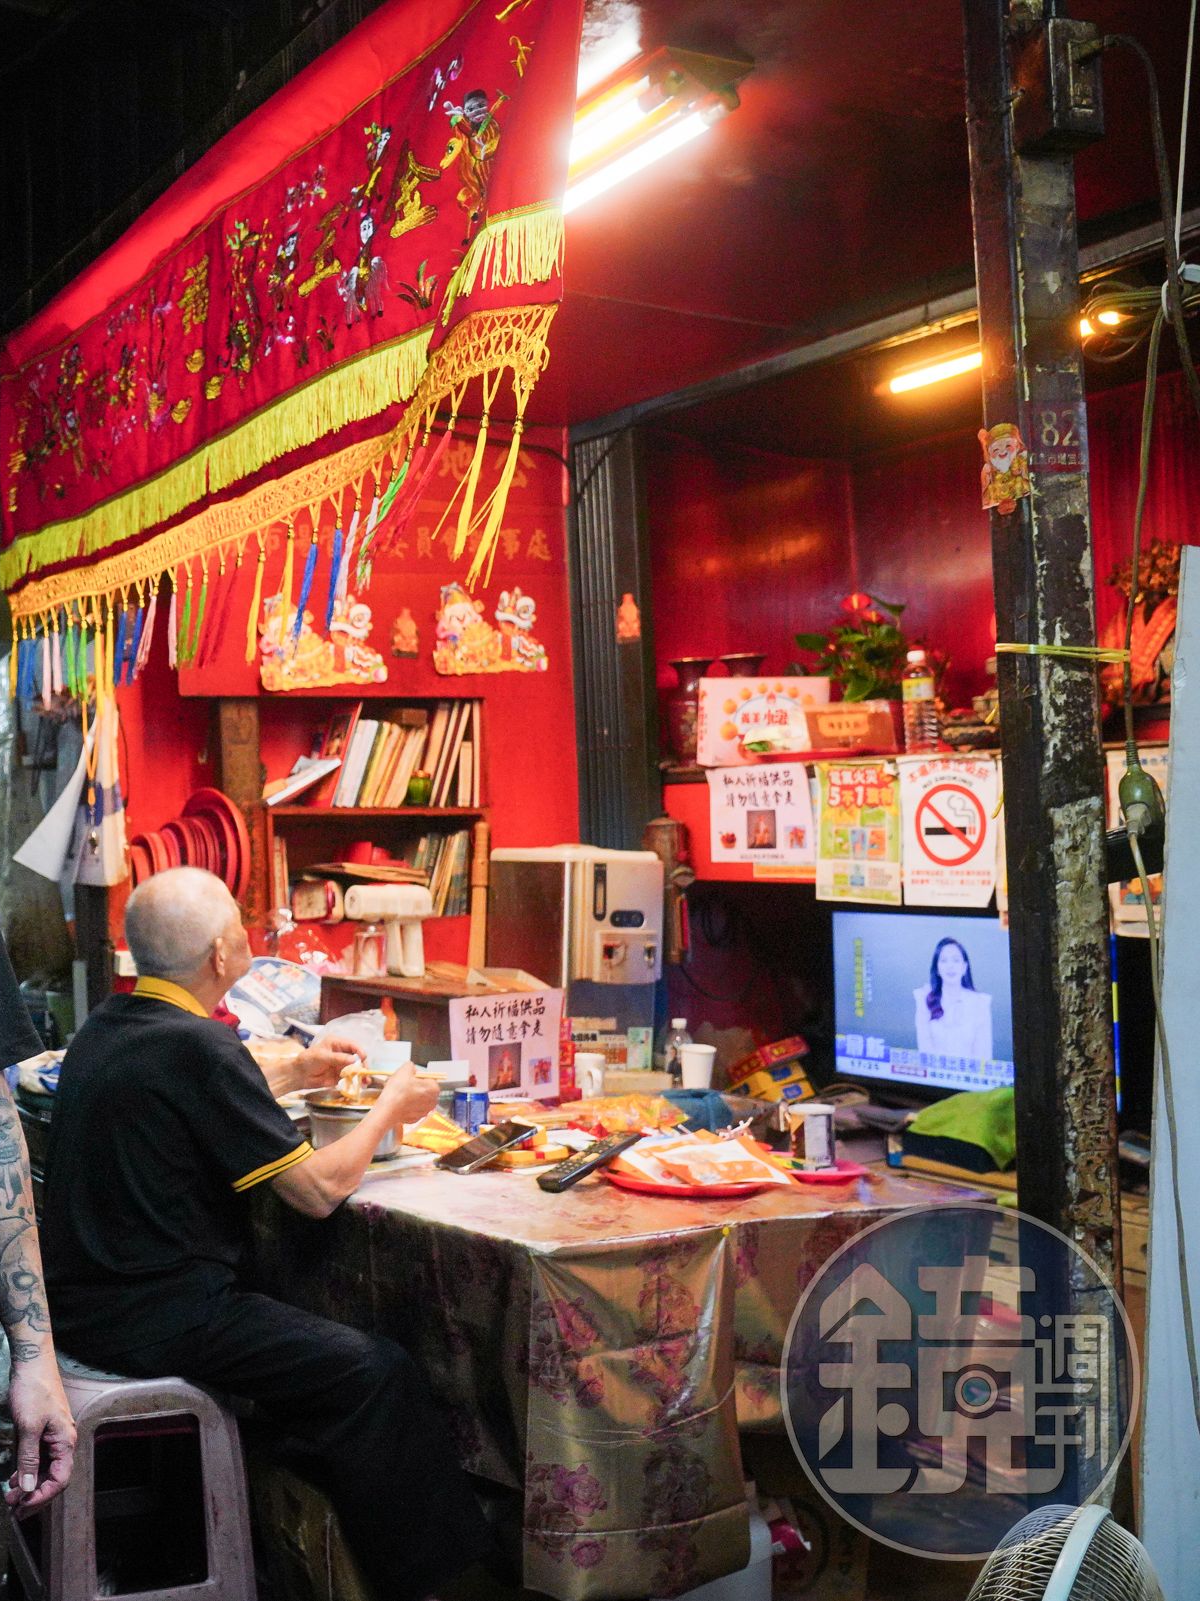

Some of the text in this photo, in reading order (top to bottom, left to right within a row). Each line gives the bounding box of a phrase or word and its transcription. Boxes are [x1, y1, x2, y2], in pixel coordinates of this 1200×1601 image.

[464, 996, 546, 1022] 私人祈福供品
[465, 1018, 545, 1046] 請勿隨意拿走
